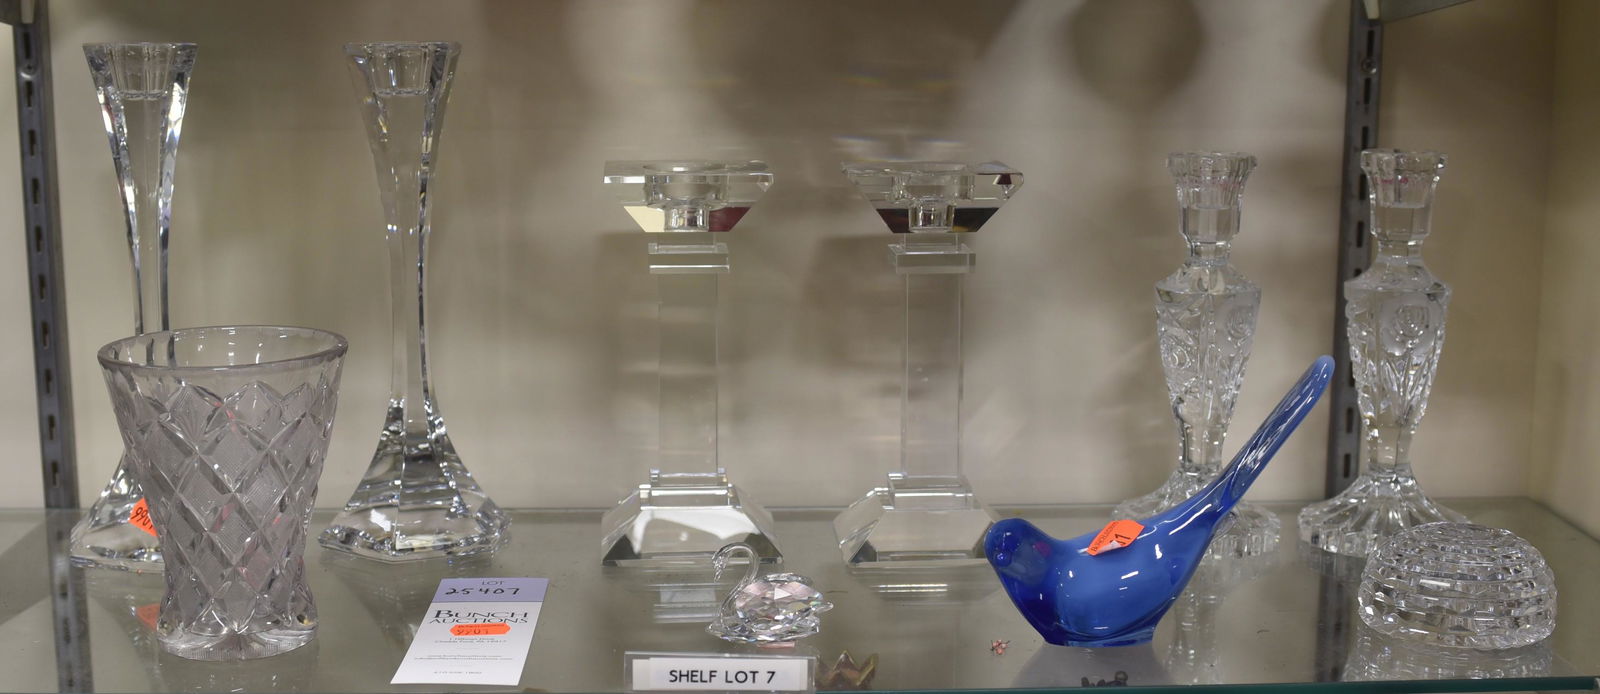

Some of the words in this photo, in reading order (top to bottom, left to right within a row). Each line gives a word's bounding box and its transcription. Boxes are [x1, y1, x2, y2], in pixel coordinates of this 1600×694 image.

[435, 610, 528, 618] BUNCH
[669, 670, 717, 683] SHELF
[725, 670, 759, 683] LOT
[766, 671, 776, 684] 7
